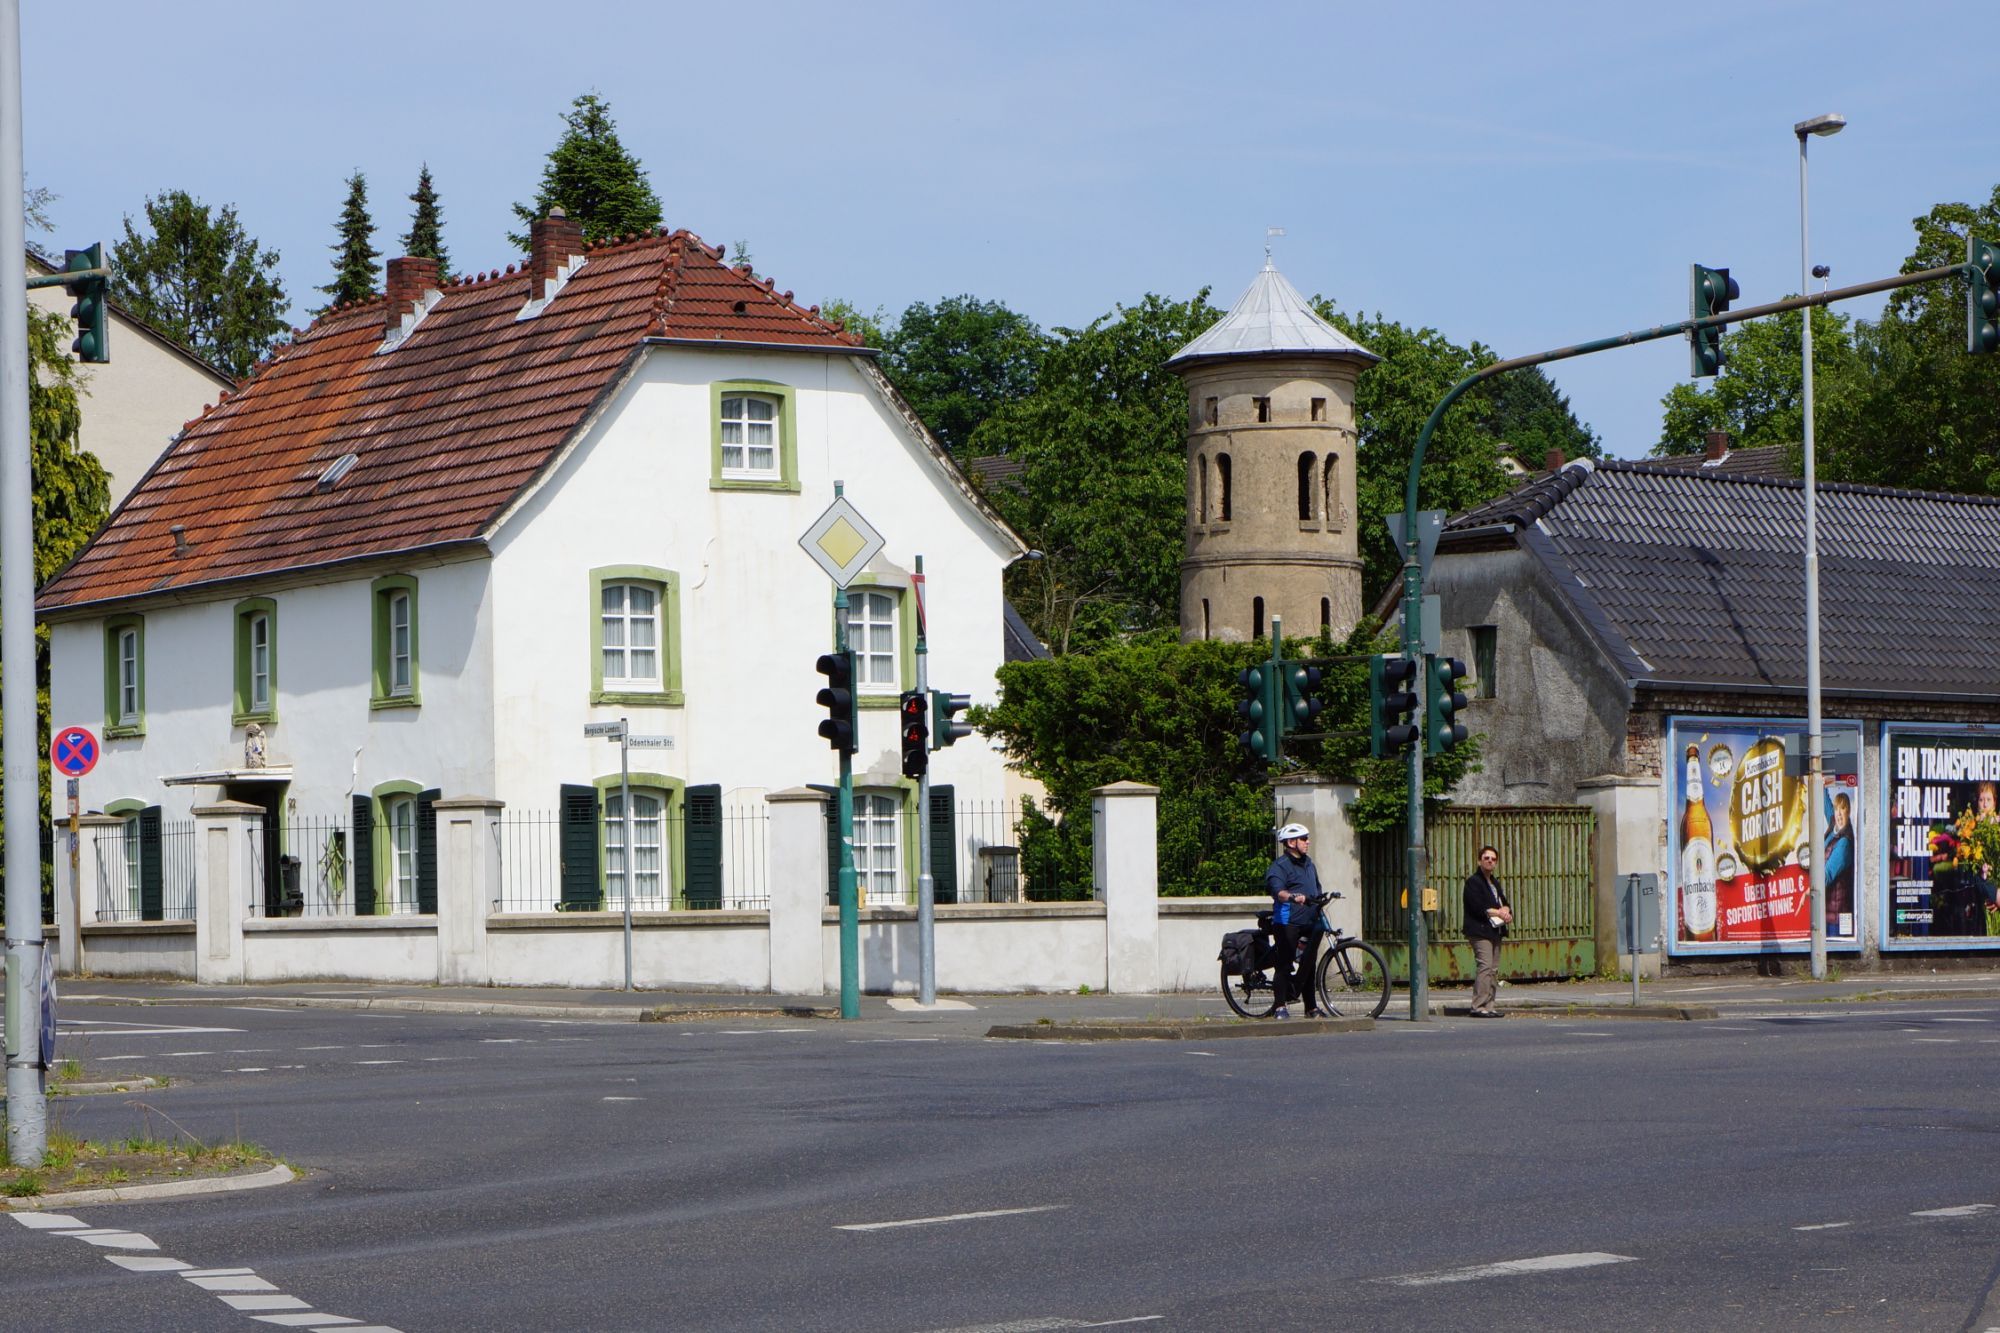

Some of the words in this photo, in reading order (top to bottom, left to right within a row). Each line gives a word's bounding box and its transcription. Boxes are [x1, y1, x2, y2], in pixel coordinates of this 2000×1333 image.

[630, 738, 661, 747] Odenthaler
[663, 738, 674, 747] Str.
[1898, 747, 1918, 779] EIN
[1741, 768, 1783, 816] CASH
[1897, 780, 1921, 819] FÜR
[1923, 786, 1951, 819] ALLE
[1741, 805, 1783, 843] KORKEN
[1684, 878, 1715, 895] Krombache
[1743, 881, 1766, 902] ÜBER
[1768, 882, 1778, 897] 14
[1779, 878, 1797, 895] MIO.
[1798, 875, 1805, 892] €
[1897, 911, 1933, 921] enterprise
